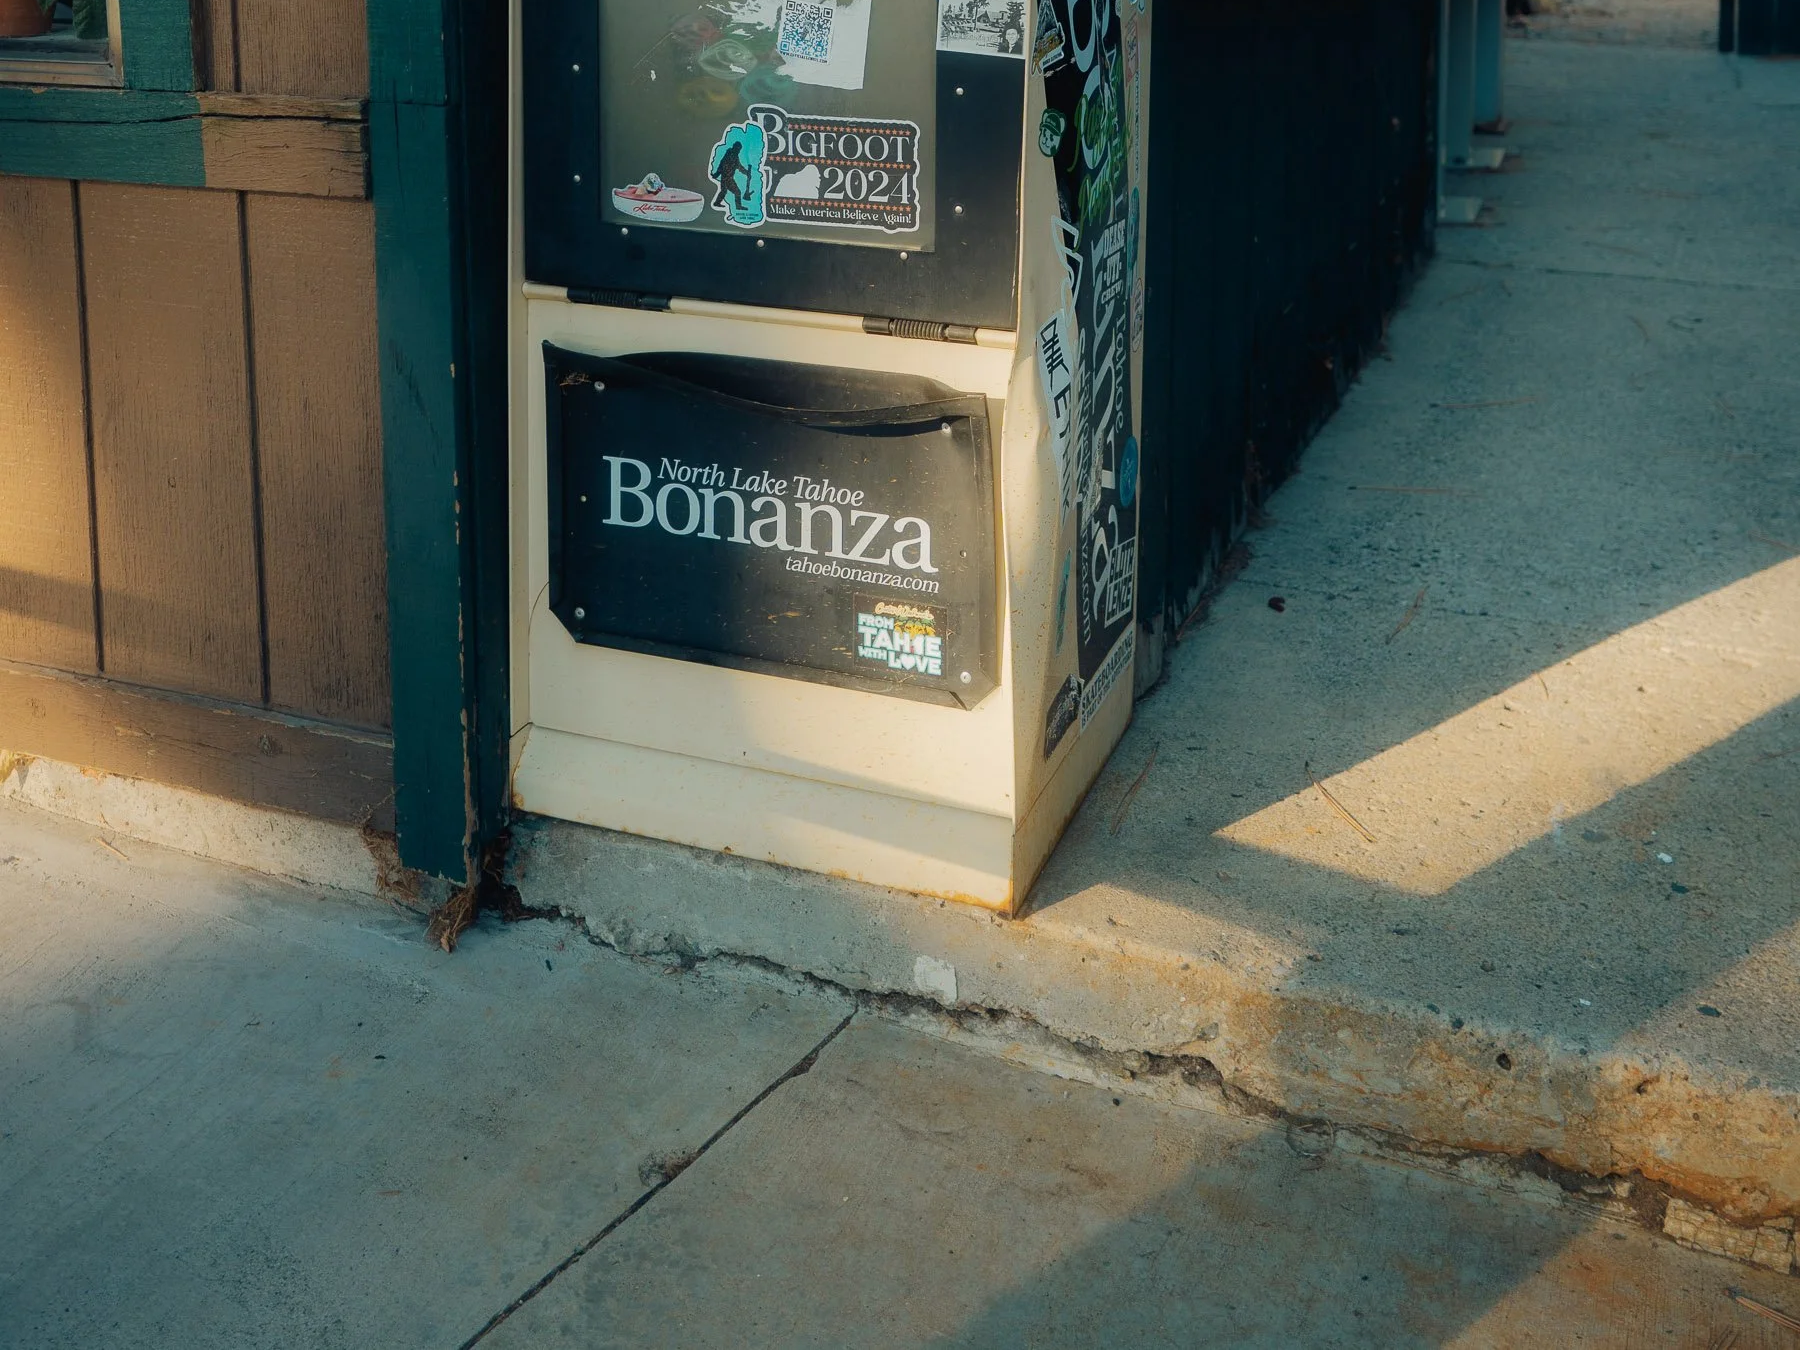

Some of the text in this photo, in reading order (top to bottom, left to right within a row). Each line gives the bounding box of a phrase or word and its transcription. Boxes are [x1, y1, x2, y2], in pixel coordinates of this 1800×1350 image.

[755, 112, 911, 163] BIGFOOT
[823, 167, 912, 205] 2024
[769, 203, 796, 216] Make
[797, 205, 841, 219] America
[843, 208, 879, 222] Believe
[880, 212, 912, 226] Again!
[1114, 301, 1126, 435] Tahoe
[658, 457, 865, 507] North Lake Tahoe
[602, 455, 940, 574] Bonanza
[785, 555, 940, 594] tahoebonanza.com
[858, 613, 895, 630] FROM
[858, 646, 888, 661] WITH
